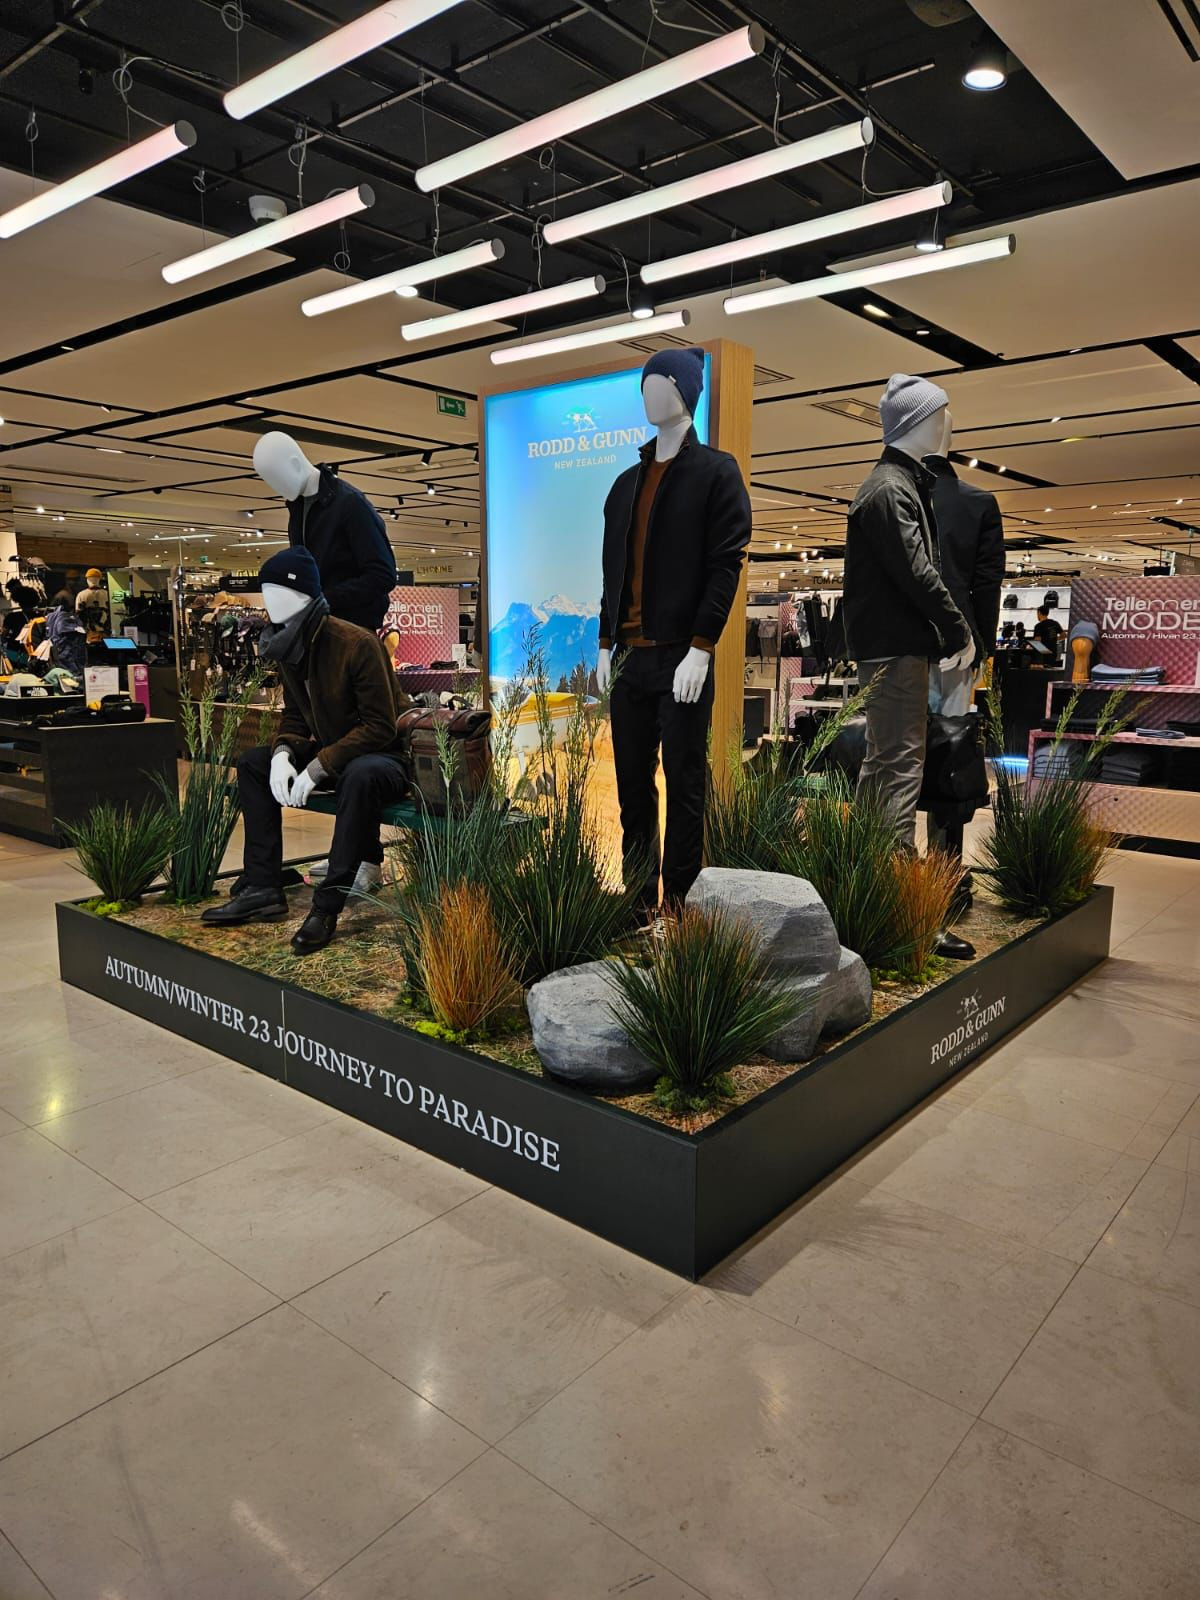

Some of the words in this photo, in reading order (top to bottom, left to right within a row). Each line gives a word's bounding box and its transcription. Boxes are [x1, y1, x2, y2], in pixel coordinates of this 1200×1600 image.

[528, 437, 575, 458] RODD
[577, 435, 591, 451] &
[592, 426, 647, 449] GUNN
[554, 460, 573, 470] NEW
[576, 454, 617, 467] ZEALAND
[832, 576, 844, 584] FO
[388, 601, 444, 613] ellement
[1101, 632, 1146, 640] Automne
[930, 1026, 965, 1065] RODD
[965, 1020, 974, 1039] &
[975, 996, 1006, 1031] GUNN
[949, 1053, 962, 1068] NEW
[963, 1032, 989, 1056] ZEALAND
[105, 955, 246, 1034] AUTUMN/WINTER
[249, 1015, 270, 1043] 23
[274, 1025, 376, 1088] JOURNEY
[379, 1069, 414, 1105] TO
[418, 1085, 560, 1172] PARADISE
